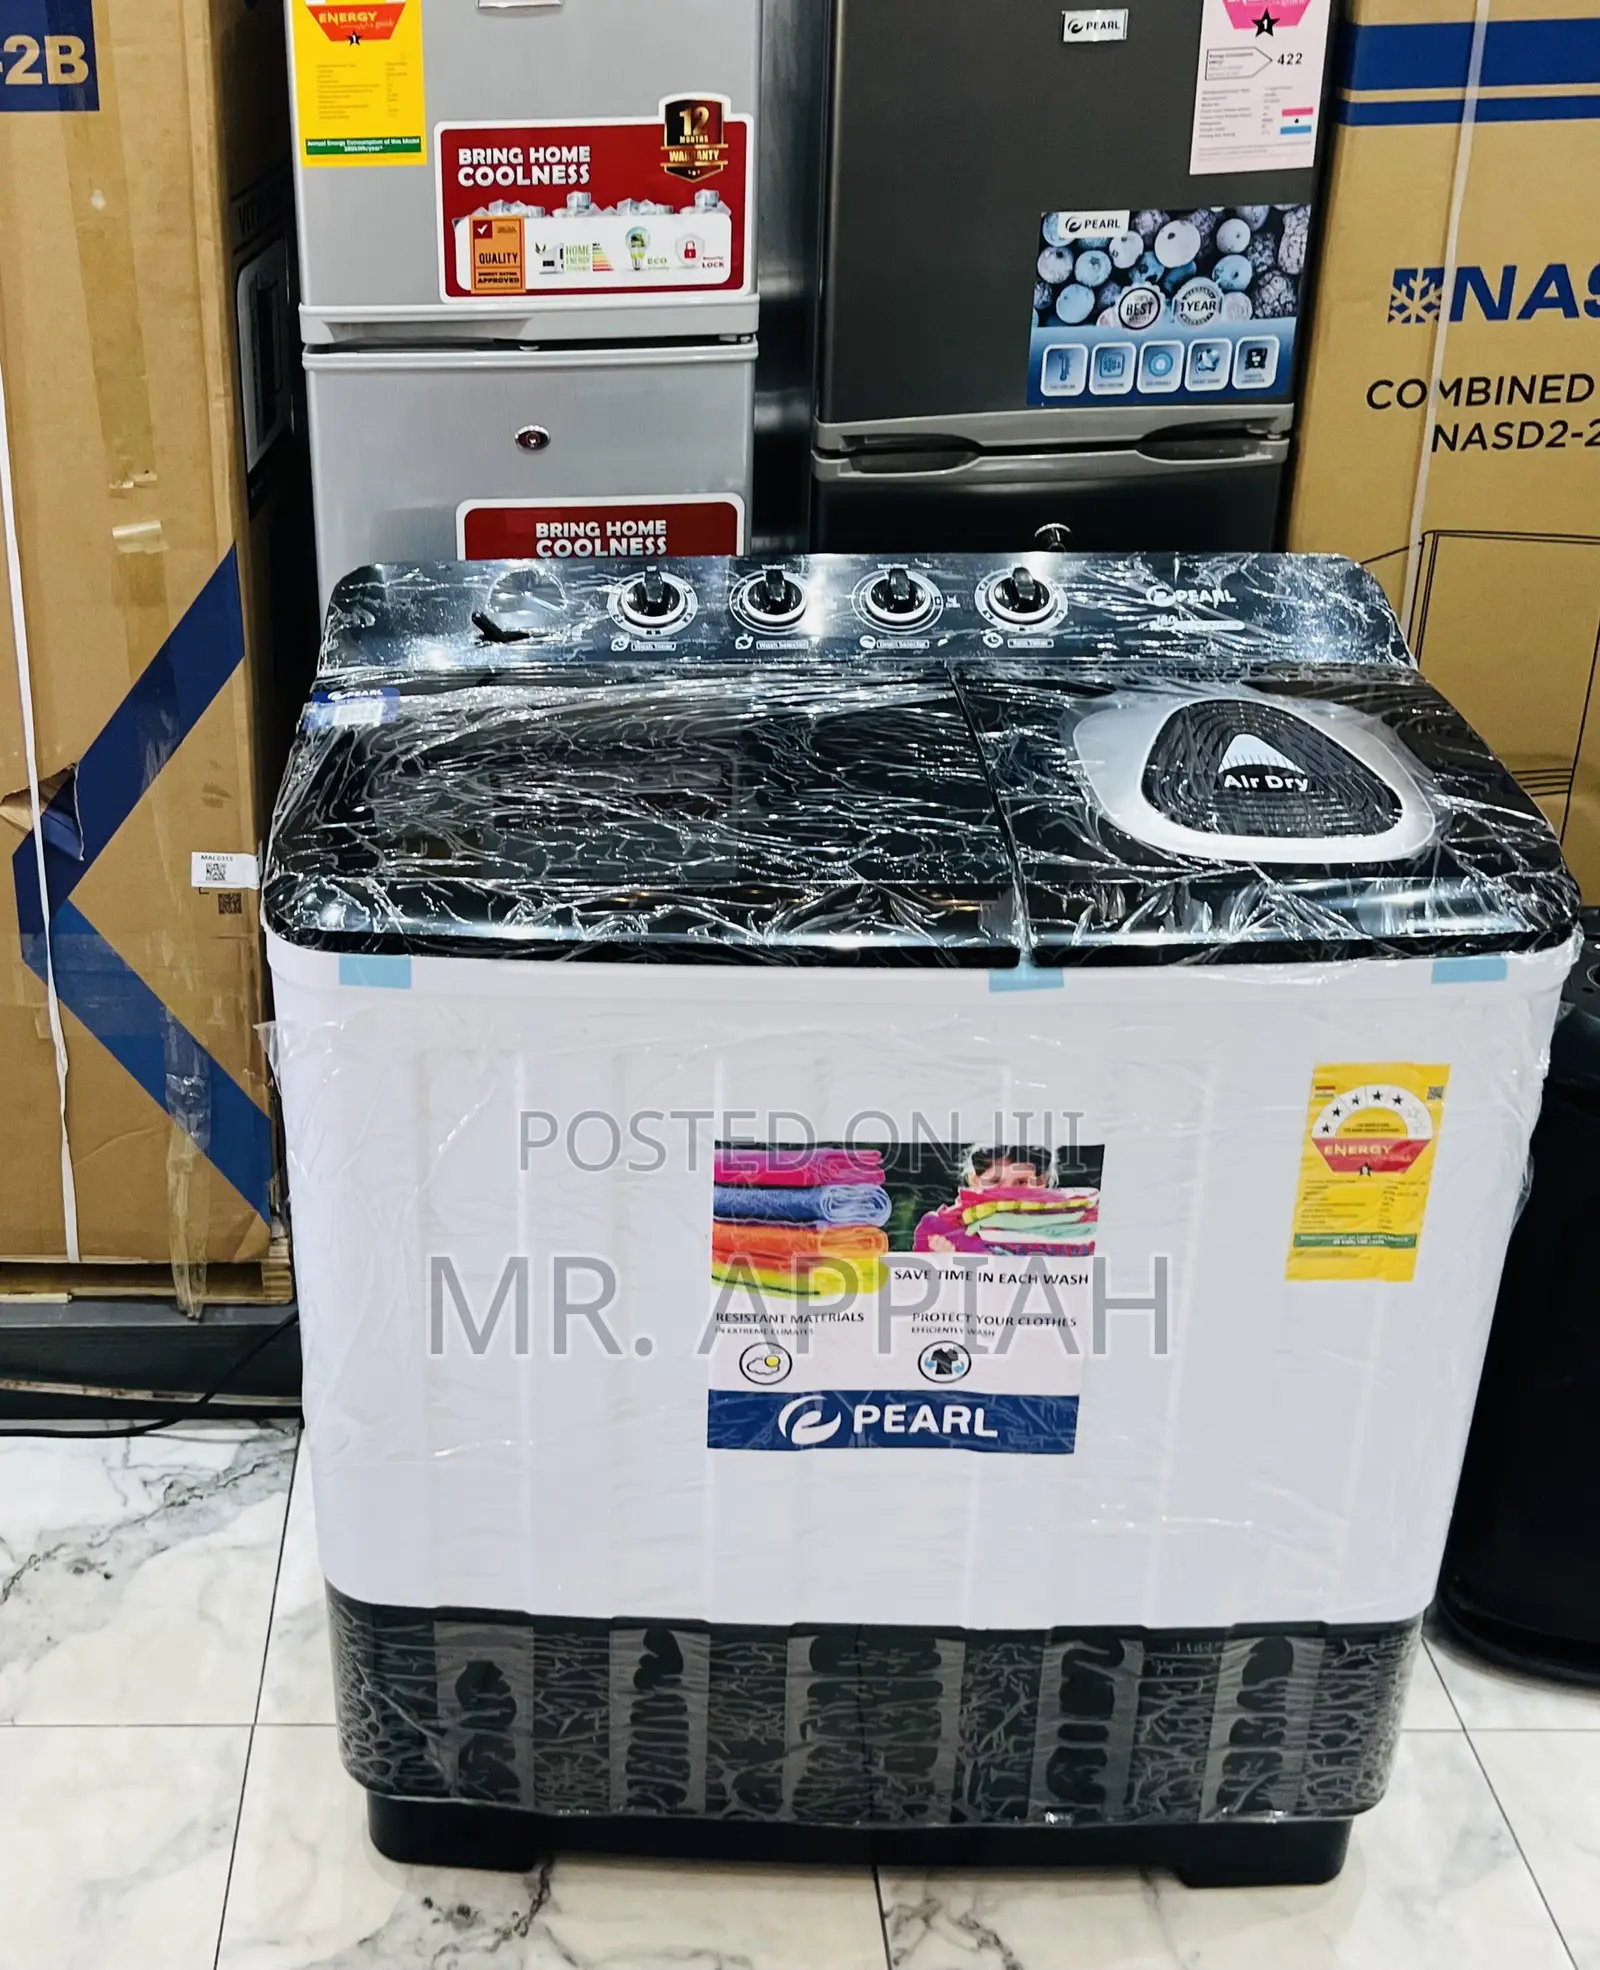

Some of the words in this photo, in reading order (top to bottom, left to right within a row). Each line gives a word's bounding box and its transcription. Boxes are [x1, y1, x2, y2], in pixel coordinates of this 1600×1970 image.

[318, 11, 378, 25] ENERGY
[1262, 18, 1268, 30] 1
[1086, 20, 1121, 31] PEARL
[0, 34, 89, 85] 2B
[1277, 52, 1303, 65] 422
[679, 106, 710, 136] 12
[458, 146, 523, 165] BRING
[529, 146, 591, 164] HOME
[669, 148, 720, 162] WARANTY
[457, 165, 591, 187] COOLNESS
[1084, 218, 1121, 229] PEARL
[565, 245, 591, 256] HOME
[479, 252, 518, 265] QUALITY
[647, 257, 668, 265] ECO
[701, 261, 725, 269] LOCK
[1126, 302, 1153, 316] BEST
[1366, 373, 1595, 410] COMBINED
[1431, 419, 1600, 453] NASD2-2
[535, 521, 600, 538] BRING
[606, 520, 667, 537] HOME
[535, 537, 667, 558] COOLNESS
[1174, 589, 1237, 603] PEARL
[349, 689, 384, 698] PEARL
[1264, 775, 1309, 792] Dry
[1323, 1142, 1392, 1157] ENERGY
[894, 1269, 931, 1281] SAVE
[937, 1270, 975, 1282] TIME
[978, 1271, 994, 1283] IN
[999, 1272, 1038, 1285] EACH
[1043, 1273, 1089, 1286] WASH
[716, 1312, 789, 1324] RESISTANT
[791, 1312, 864, 1324] MATERIALS
[912, 1312, 972, 1323] PROTECT
[976, 1314, 1014, 1326] YOUR
[1017, 1316, 1077, 1328] CLOTHES
[911, 1327, 963, 1335] EFFICIENTLY
[967, 1328, 995, 1337] WASH
[853, 1403, 998, 1440] PEARL
